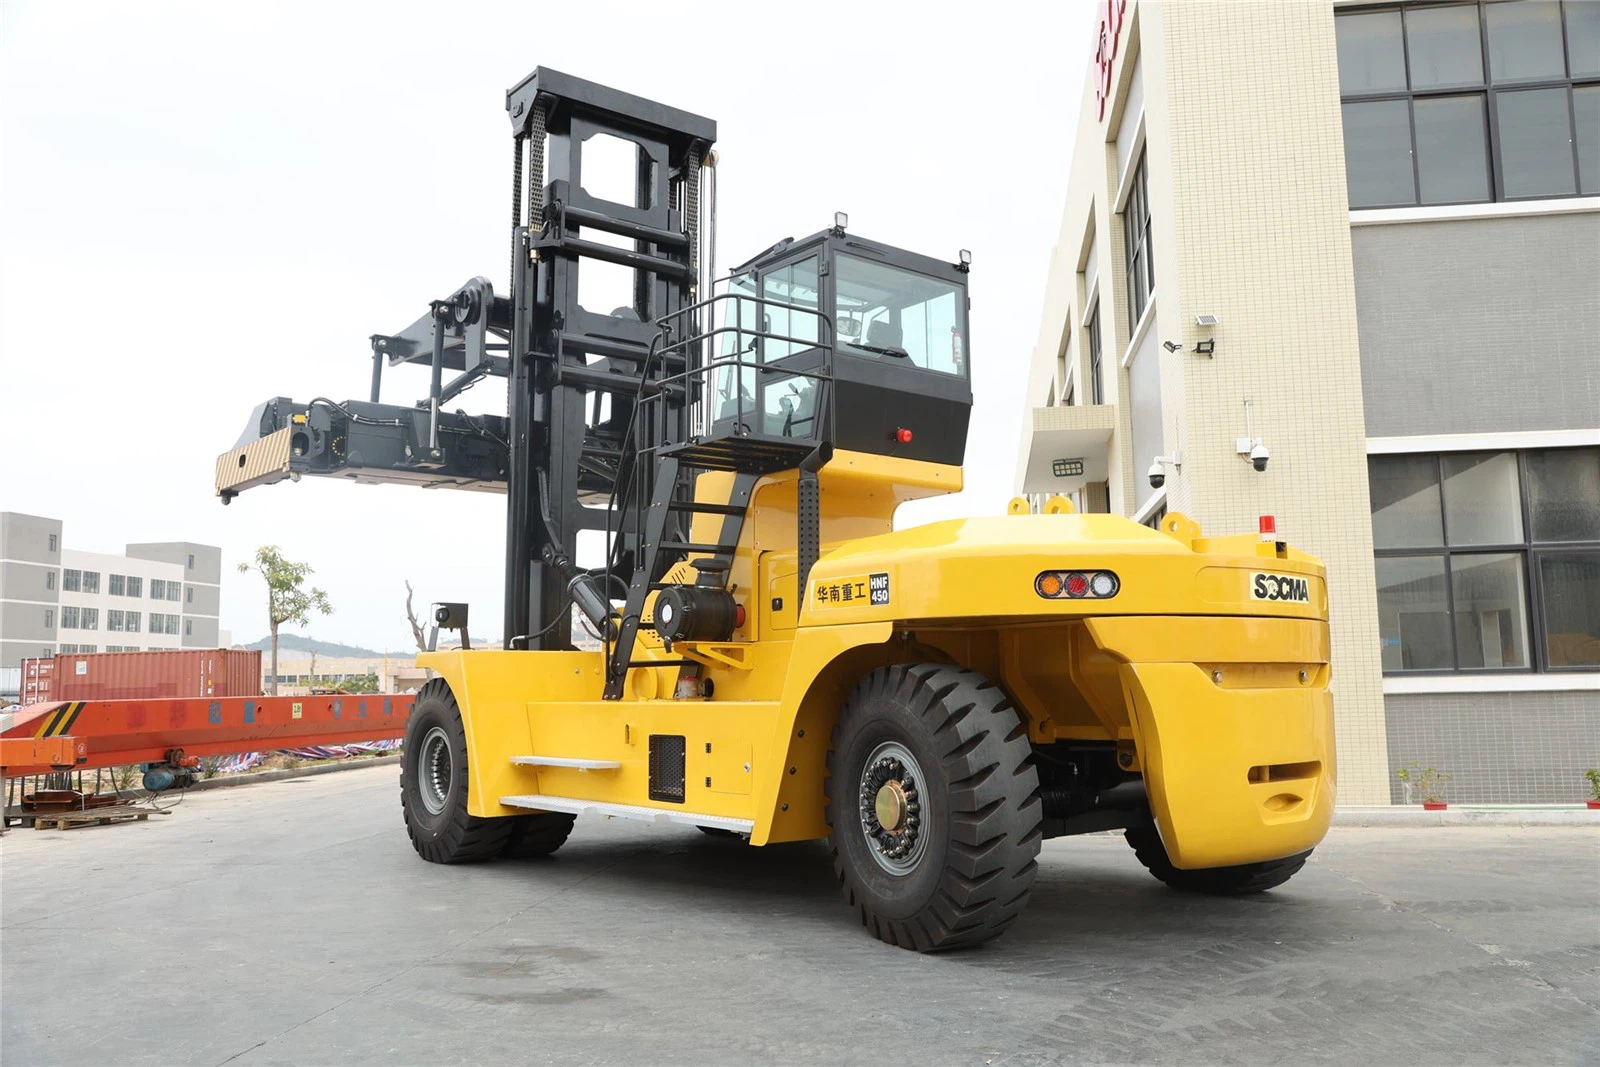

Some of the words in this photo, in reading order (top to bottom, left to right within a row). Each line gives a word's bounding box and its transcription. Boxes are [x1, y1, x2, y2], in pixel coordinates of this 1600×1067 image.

[870, 577, 888, 590] HNF
[1254, 573, 1309, 601] SOCMA
[817, 583, 866, 603] 华南重工
[871, 590, 888, 602] 450
